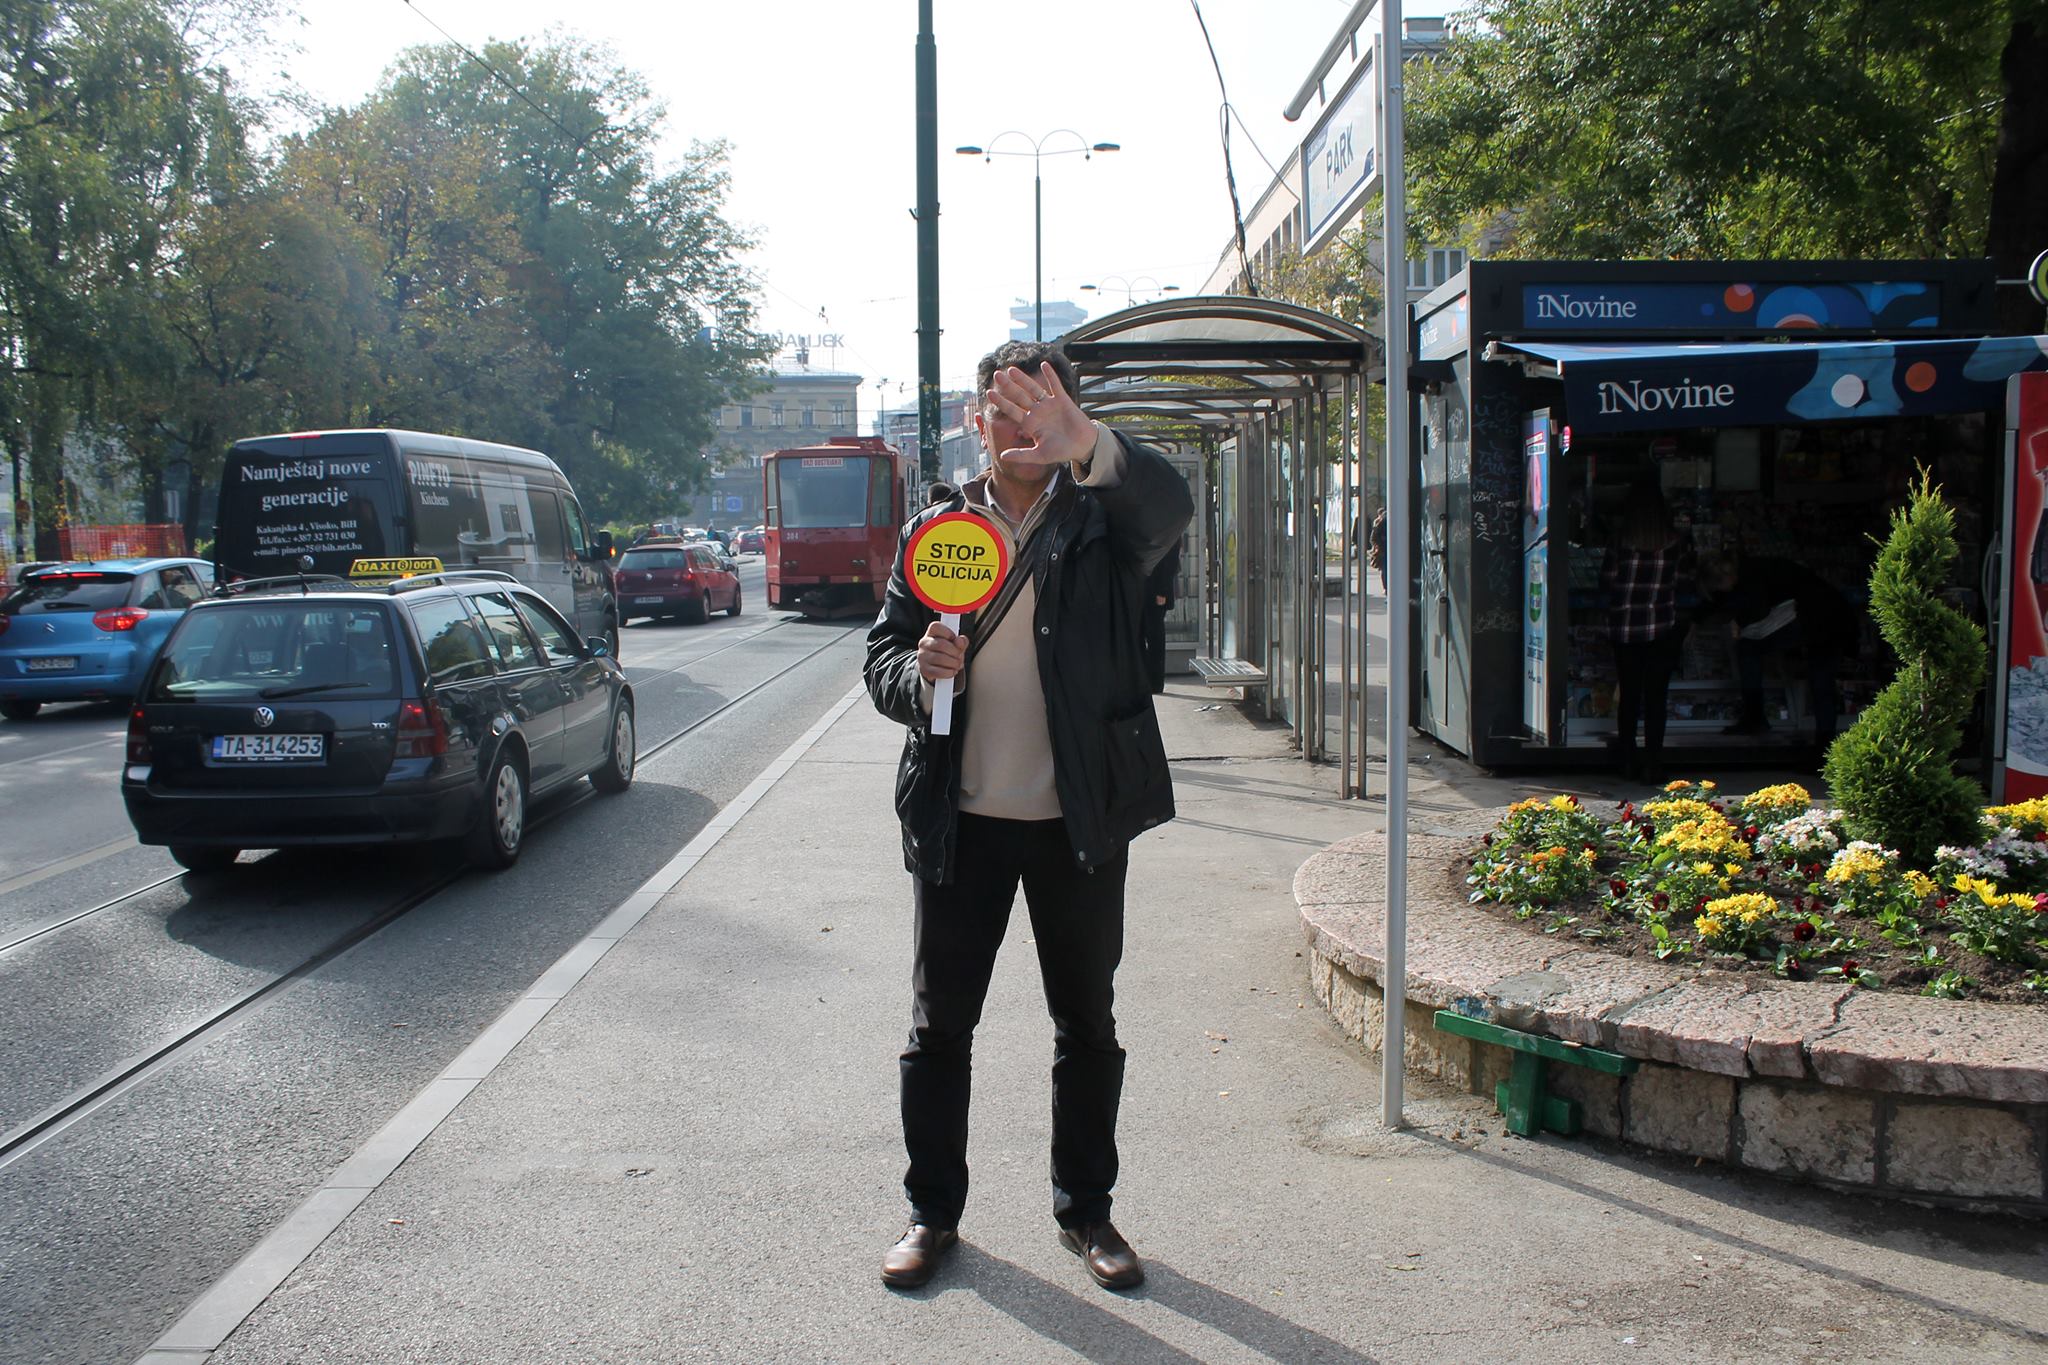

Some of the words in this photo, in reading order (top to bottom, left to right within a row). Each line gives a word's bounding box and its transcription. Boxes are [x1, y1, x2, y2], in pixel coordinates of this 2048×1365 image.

[1326, 121, 1354, 189] PARK
[1537, 294, 1637, 318] iNovine
[1598, 378, 1735, 415] iNovine
[241, 460, 325, 483] Namještaj
[329, 462, 371, 476] nove
[408, 460, 450, 488] PINETO
[262, 487, 349, 511] generacije
[256, 524, 298, 535] Kakanjska
[929, 542, 986, 562] STOP
[356, 560, 396, 572] TAXI
[916, 563, 993, 582] POLICIJA
[224, 736, 322, 755] TA-314253
